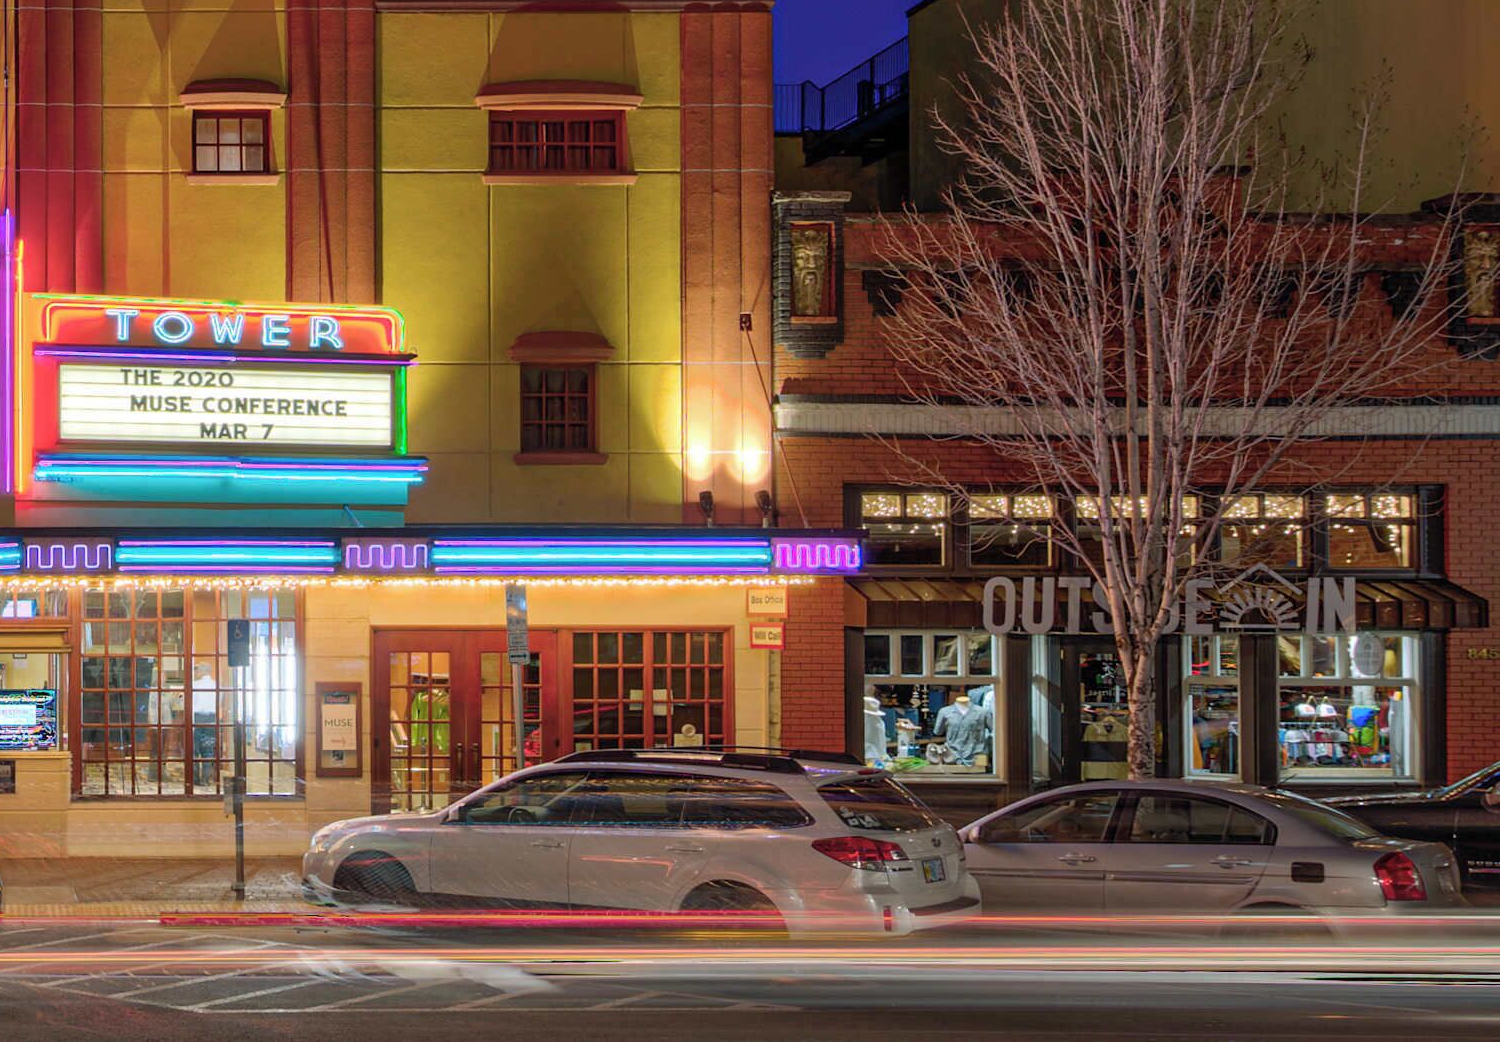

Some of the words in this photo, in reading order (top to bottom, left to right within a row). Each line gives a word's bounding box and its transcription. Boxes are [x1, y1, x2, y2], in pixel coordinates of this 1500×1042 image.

[106, 309, 344, 350] TOWER
[121, 369, 162, 385] THE
[173, 370, 234, 387] 2020
[130, 395, 192, 413] MUSE
[202, 397, 348, 417] CONFERENCE
[200, 423, 248, 440] MAR
[261, 424, 274, 440] 7
[983, 576, 1214, 635] OUTSE
[1307, 577, 1356, 636] IN
[324, 719, 353, 727] MUSE
